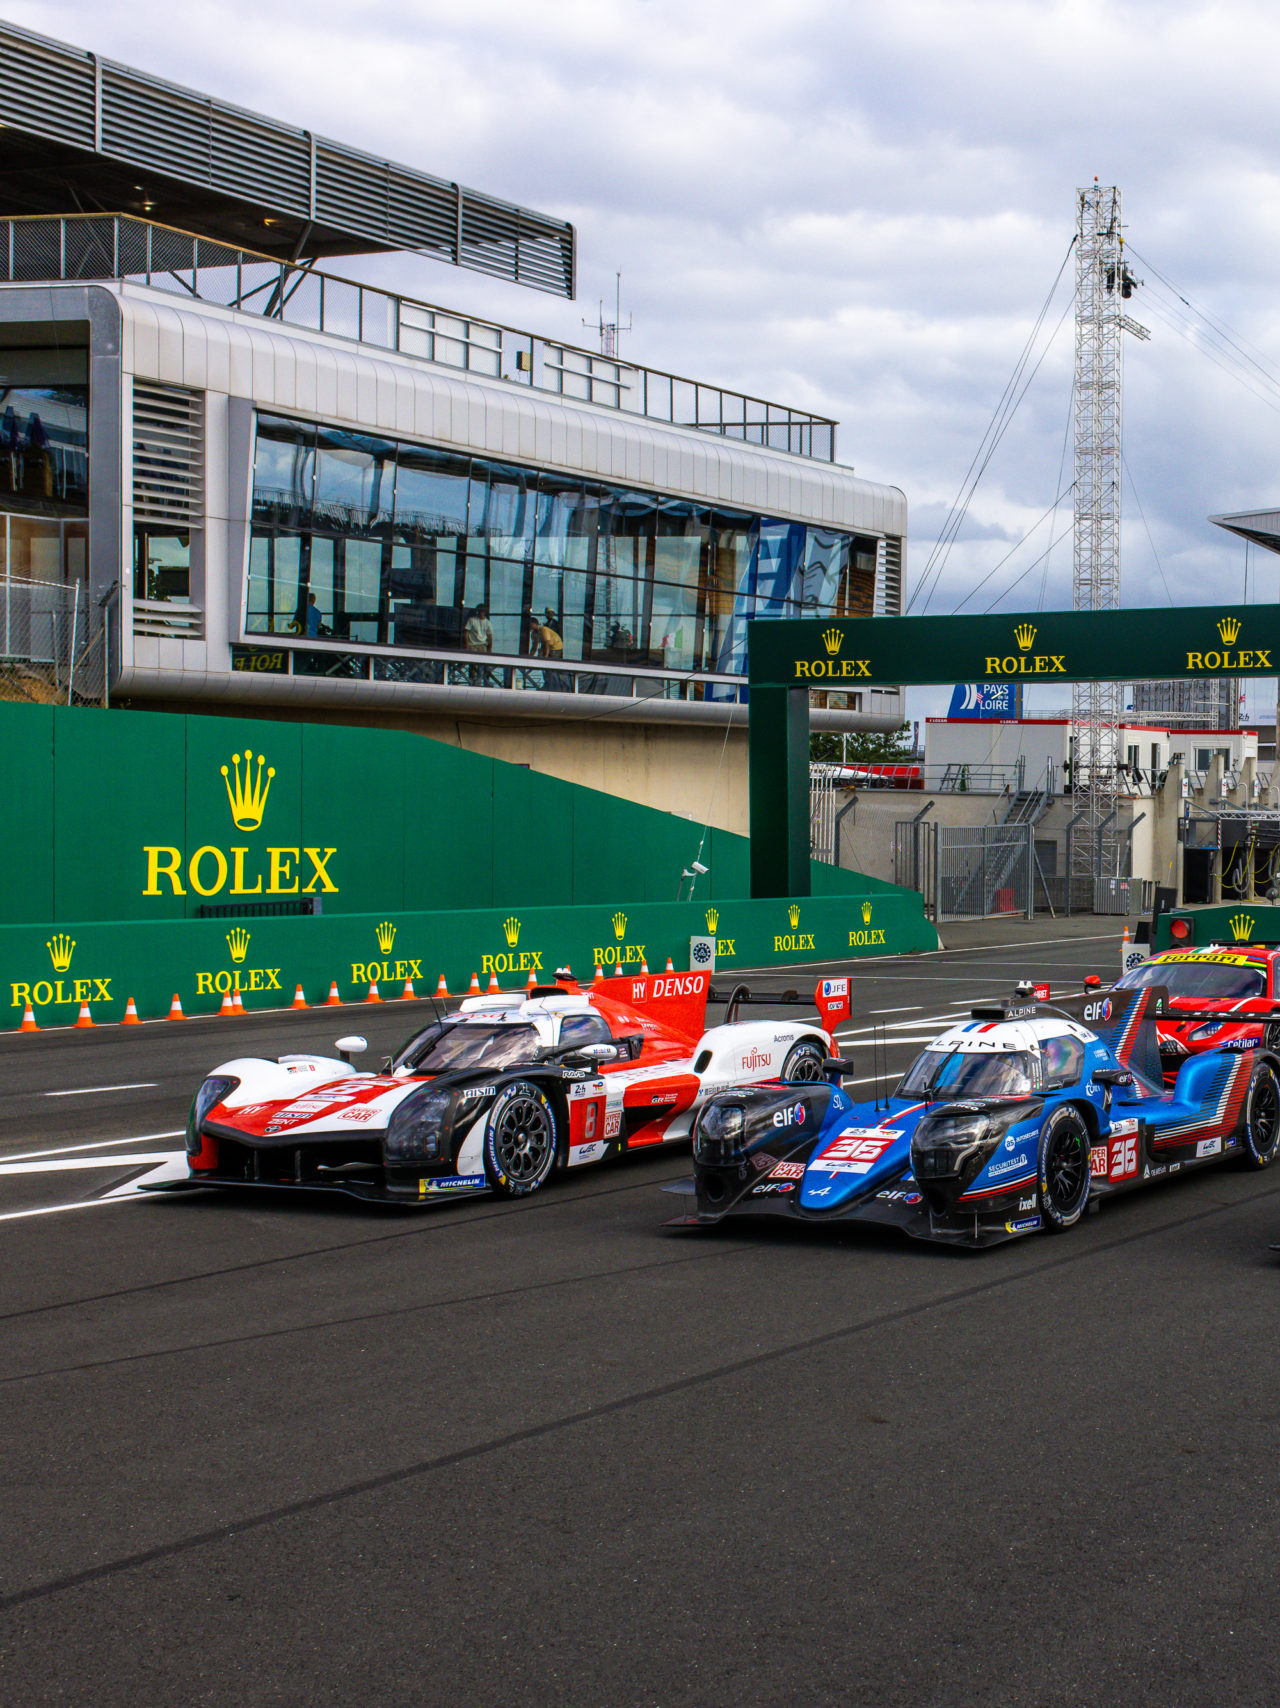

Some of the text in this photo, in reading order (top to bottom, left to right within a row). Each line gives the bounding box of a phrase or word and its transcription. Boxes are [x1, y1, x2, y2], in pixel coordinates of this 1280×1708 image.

[985, 656, 1066, 674] ROLEX
[1186, 651, 1273, 669] ROLEX
[795, 660, 873, 677] ROLEX
[984, 685, 1008, 694] PAYS
[980, 701, 1008, 710] LOIRE
[142, 845, 339, 896] ROLEX
[774, 934, 816, 952] ROLEX
[848, 930, 886, 946] ROLEX
[481, 951, 544, 974] ROLEX
[593, 945, 646, 966] ROLEX
[1163, 954, 1240, 964] Ferrari
[351, 959, 424, 984] ROLEX
[196, 968, 282, 994] ROLEX
[633, 976, 704, 999] HY DENSO
[831, 984, 846, 993] JFE
[10, 978, 114, 1006] ROLEX
[1008, 1007, 1036, 1018] ALPINE
[1084, 1001, 1102, 1021] elf
[774, 1034, 794, 1043] Acronis
[930, 1041, 1017, 1050] ALPINE
[742, 1053, 772, 1072] FUJITSU
[239, 1105, 266, 1115] HY
[344, 1112, 371, 1120] CAR
[606, 1112, 620, 1122] HYPER
[585, 1102, 598, 1138] 8
[773, 1109, 794, 1128] elf
[606, 1121, 619, 1136] CAR
[488, 1130, 505, 1178] MICHELIN
[578, 1144, 596, 1154] WEC
[822, 1139, 890, 1160] 36
[1092, 1148, 1106, 1158] PER
[1091, 1158, 1106, 1174] AR
[1110, 1138, 1137, 1178] 36
[777, 1168, 803, 1178] CAR
[440, 1178, 480, 1188] MICHELIN
[752, 1184, 778, 1194] elf
[876, 1190, 906, 1200] elf
[1019, 1194, 1037, 1212] ixell
